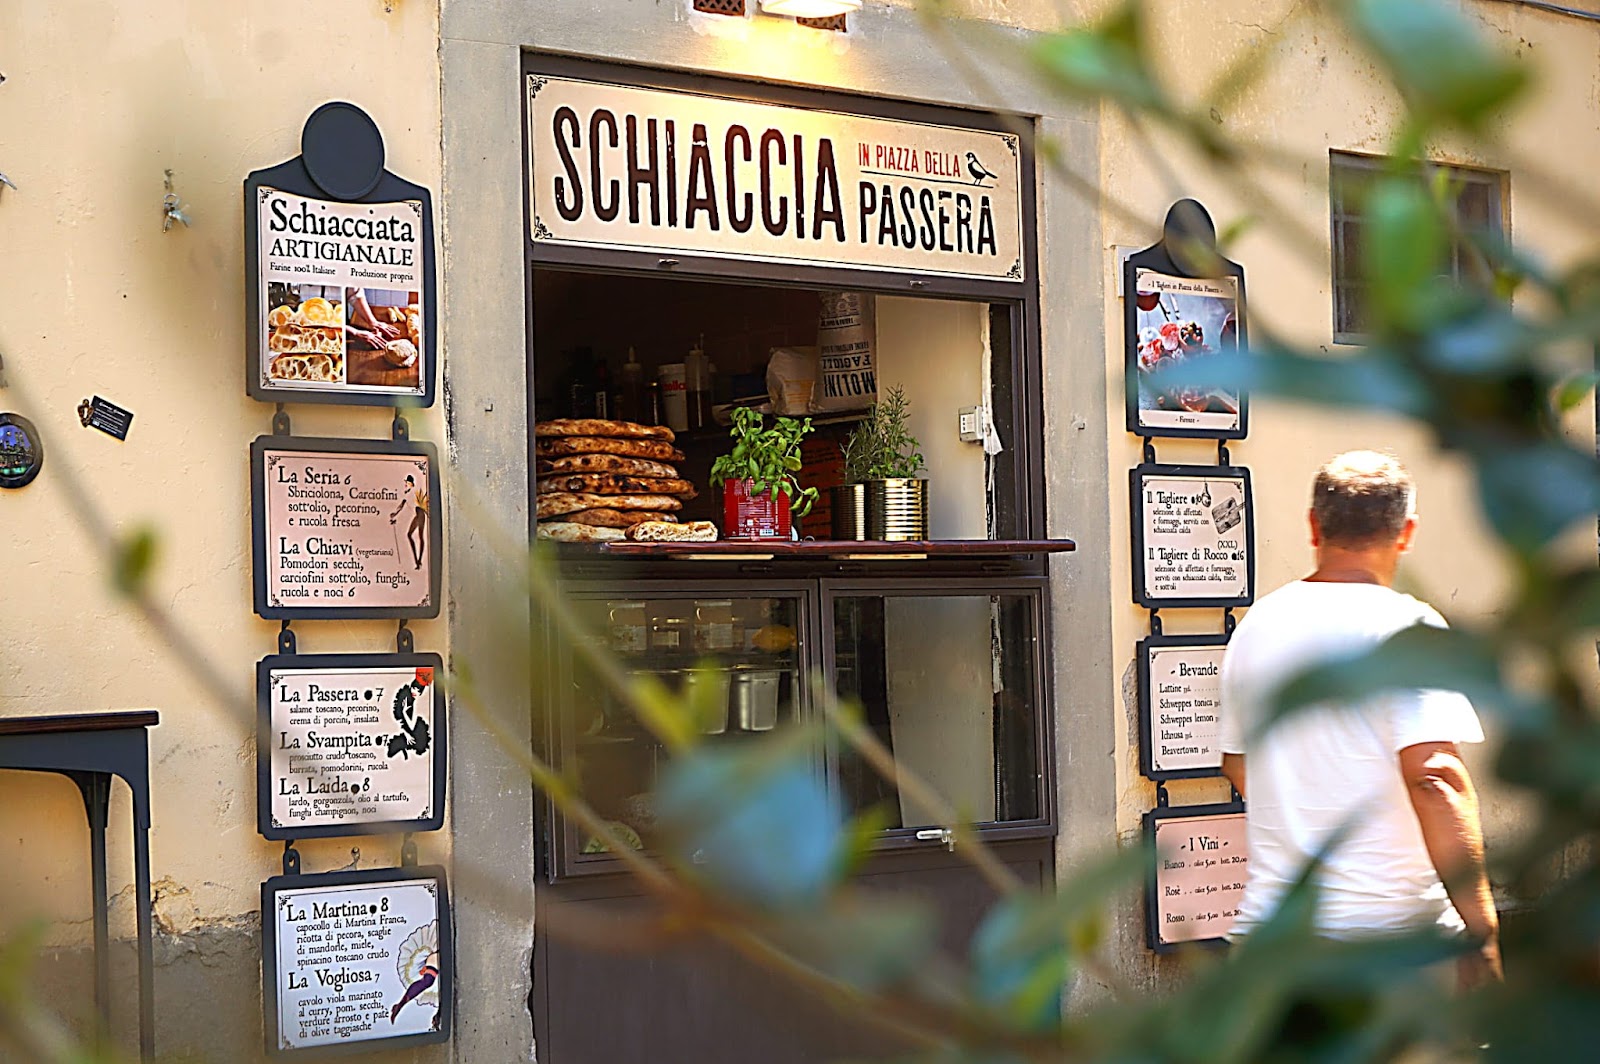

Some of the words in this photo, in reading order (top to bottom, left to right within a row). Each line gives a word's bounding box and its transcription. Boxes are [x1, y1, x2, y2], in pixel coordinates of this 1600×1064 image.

[858, 142, 871, 168] IN
[876, 145, 919, 174] PIAZZA
[925, 152, 961, 178] DELLA
[552, 106, 846, 242] SCHIACCIA
[270, 199, 414, 242] Schiacciata
[860, 181, 997, 256] PASSERA
[270, 239, 414, 266] ARTIGIANALE
[270, 262, 291, 272] Farine
[312, 265, 336, 275] Italiane
[351, 268, 387, 279] Produzione
[390, 271, 414, 283] propria
[823, 355, 872, 369] FAGIOLI
[824, 371, 877, 397] MOLINI
[278, 466, 298, 483] La
[305, 467, 340, 485] Seria
[344, 475, 351, 485] 6
[288, 486, 344, 500] Sbriciolona,
[349, 488, 398, 500] Carciofini
[1147, 491, 1152, 503] Il
[1157, 492, 1187, 509] Tagliere
[336, 503, 380, 518] pecorino,
[288, 518, 294, 526] e
[299, 516, 328, 527] rucola
[332, 516, 360, 527] fresca
[280, 537, 300, 555] La
[306, 538, 353, 556] Chiavi
[356, 548, 394, 558] (vegetariana)
[1218, 541, 1238, 550] (XXL)
[280, 557, 328, 569] Pomodori
[333, 558, 364, 571] secchi,
[1149, 548, 1154, 560] Il
[1158, 548, 1188, 565] Tagliere
[1192, 548, 1200, 560] di
[1204, 549, 1228, 560] Rocco
[280, 571, 324, 583] carciofini
[376, 572, 410, 588] funghi,
[280, 586, 310, 598] rucola
[314, 589, 319, 597] e
[324, 587, 344, 597] noci
[348, 587, 355, 598] 6
[1180, 662, 1218, 676] Bevande
[280, 685, 300, 702] La
[308, 684, 359, 702] Passera
[376, 688, 384, 702] 7
[1160, 683, 1181, 693] Lattine
[290, 704, 312, 714] salame
[316, 705, 344, 714] toscano,
[347, 705, 380, 716] pecorino,
[1160, 699, 1192, 712] Schweppes
[1195, 698, 1212, 707] tonica
[290, 716, 311, 725] crema
[313, 714, 321, 724] di
[324, 715, 351, 727] porcini,
[354, 713, 379, 723] insalata
[1160, 715, 1192, 727] Schweppes
[1195, 713, 1214, 722] lemon
[280, 732, 300, 750] La
[307, 731, 372, 754] Svampita
[1161, 730, 1183, 740] Ichnusa
[326, 752, 346, 760] crudo
[349, 752, 376, 760] toscano,
[1162, 746, 1199, 756] Beavertown
[321, 763, 365, 776] pomodorini,
[368, 762, 388, 771] rucola
[279, 778, 300, 796] La
[306, 776, 348, 794] Laida
[362, 778, 370, 791] 8
[289, 797, 310, 806] lardo,
[313, 796, 355, 808] gorgonzola,
[358, 794, 370, 802] olio
[374, 793, 379, 801] al
[383, 792, 409, 802] tartufo,
[289, 809, 312, 820] funghi
[315, 807, 359, 820] champignon,
[362, 805, 376, 813] noci
[1190, 838, 1194, 851] I
[1198, 836, 1219, 850] Vini
[1164, 859, 1185, 870] Bianco
[286, 904, 306, 922] La
[313, 902, 367, 919] Martina
[380, 897, 389, 912] 8
[296, 922, 330, 932] capocollo
[334, 919, 342, 929] di
[346, 918, 376, 928] Martina
[380, 915, 407, 925] Franca,
[1166, 913, 1185, 923] Rosso
[297, 933, 322, 944] ricotta
[325, 931, 333, 941] di
[337, 931, 364, 944] pecora,
[368, 927, 392, 940] scaglie
[297, 945, 305, 955] di
[309, 942, 348, 954] mandorle,
[351, 940, 374, 950] miele,
[297, 956, 332, 970] spinacino
[336, 953, 364, 963] toscano
[367, 949, 389, 959] crudo
[288, 972, 308, 990] La
[315, 967, 372, 992] Vogliosa
[375, 974, 380, 983] 7
[299, 996, 322, 1007] cavolo
[327, 991, 346, 1002] viola
[349, 990, 383, 1001] marinato
[299, 1009, 305, 1018] al
[309, 1006, 332, 1017] curry,
[336, 1005, 355, 1017] pom.
[359, 1001, 384, 1011] secchi,
[299, 1017, 330, 1028] verdure
[334, 1012, 362, 1024] arrosto
[365, 1012, 370, 1020] e
[299, 1028, 307, 1038] di
[311, 1025, 330, 1036] olive
[334, 1022, 372, 1037] taggiasche
